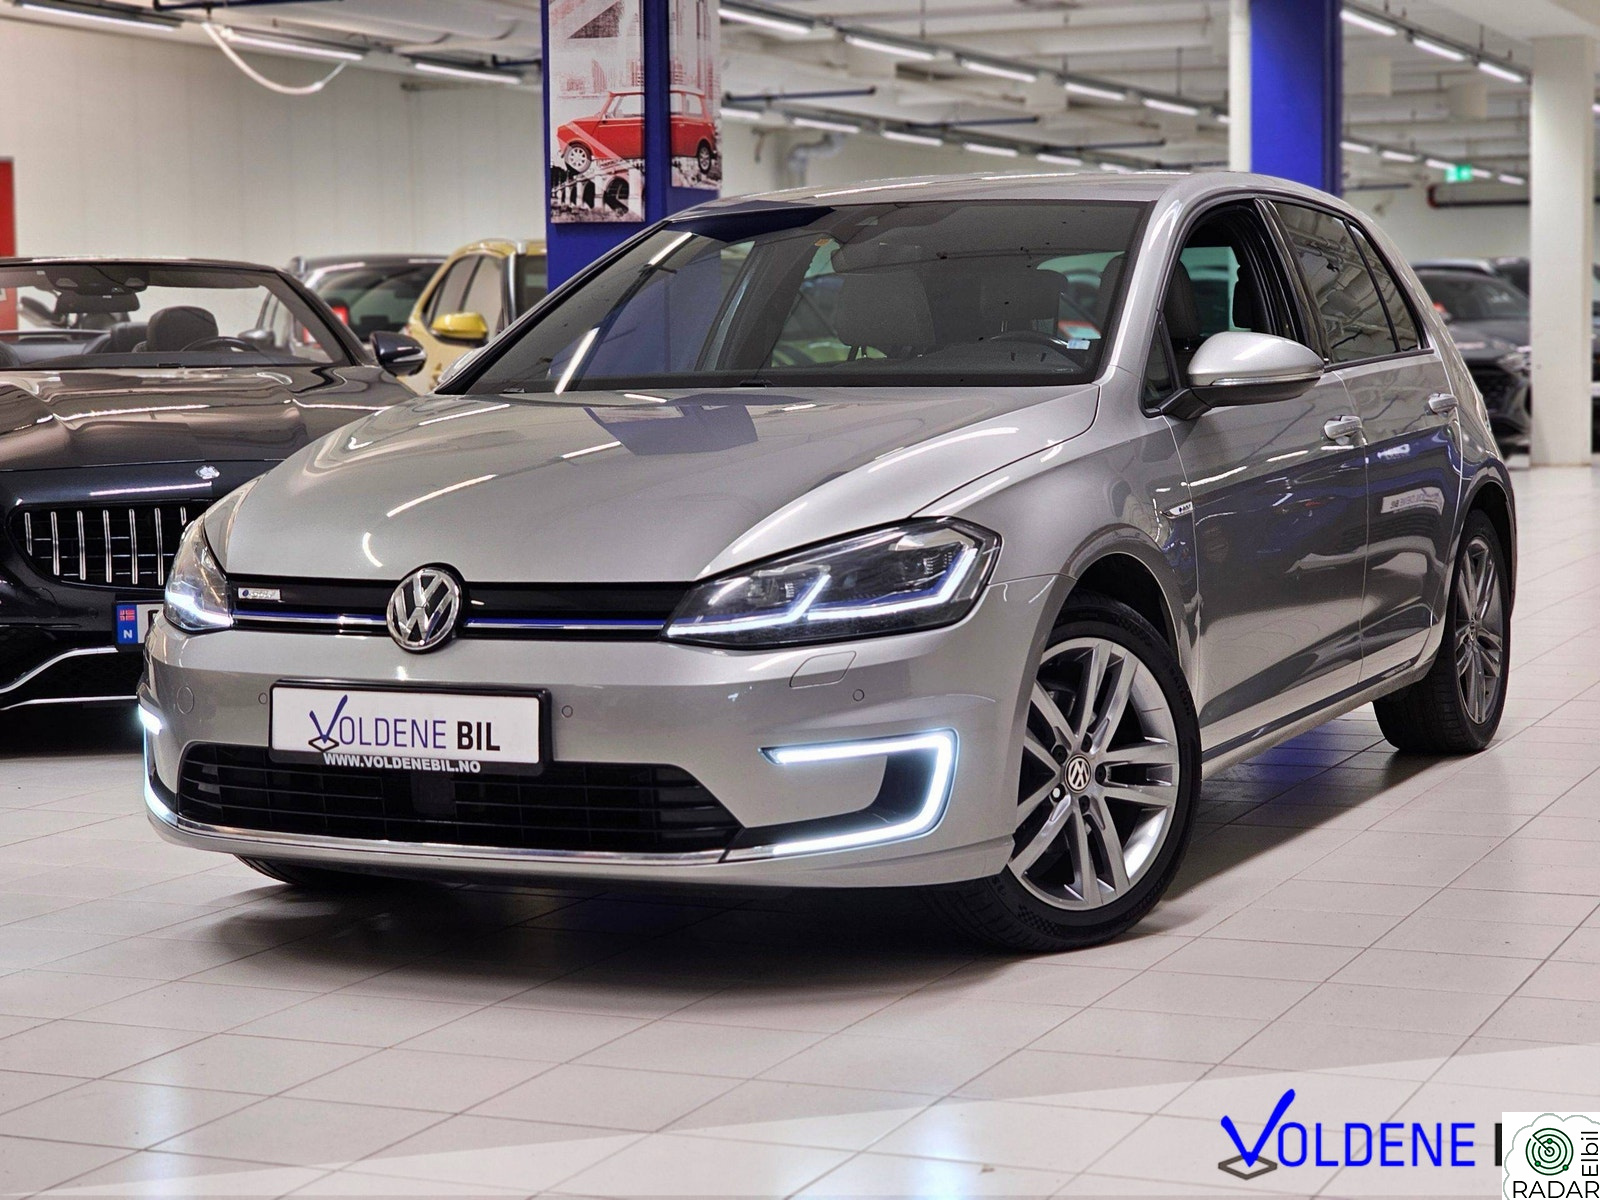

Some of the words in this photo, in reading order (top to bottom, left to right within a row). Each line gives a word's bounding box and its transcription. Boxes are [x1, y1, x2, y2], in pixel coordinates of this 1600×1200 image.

[123, 629, 133, 639] N
[308, 694, 447, 749] VOLDENE
[456, 720, 501, 752] BIL
[322, 752, 482, 774] WWW.VOLDENEBIL.NO
